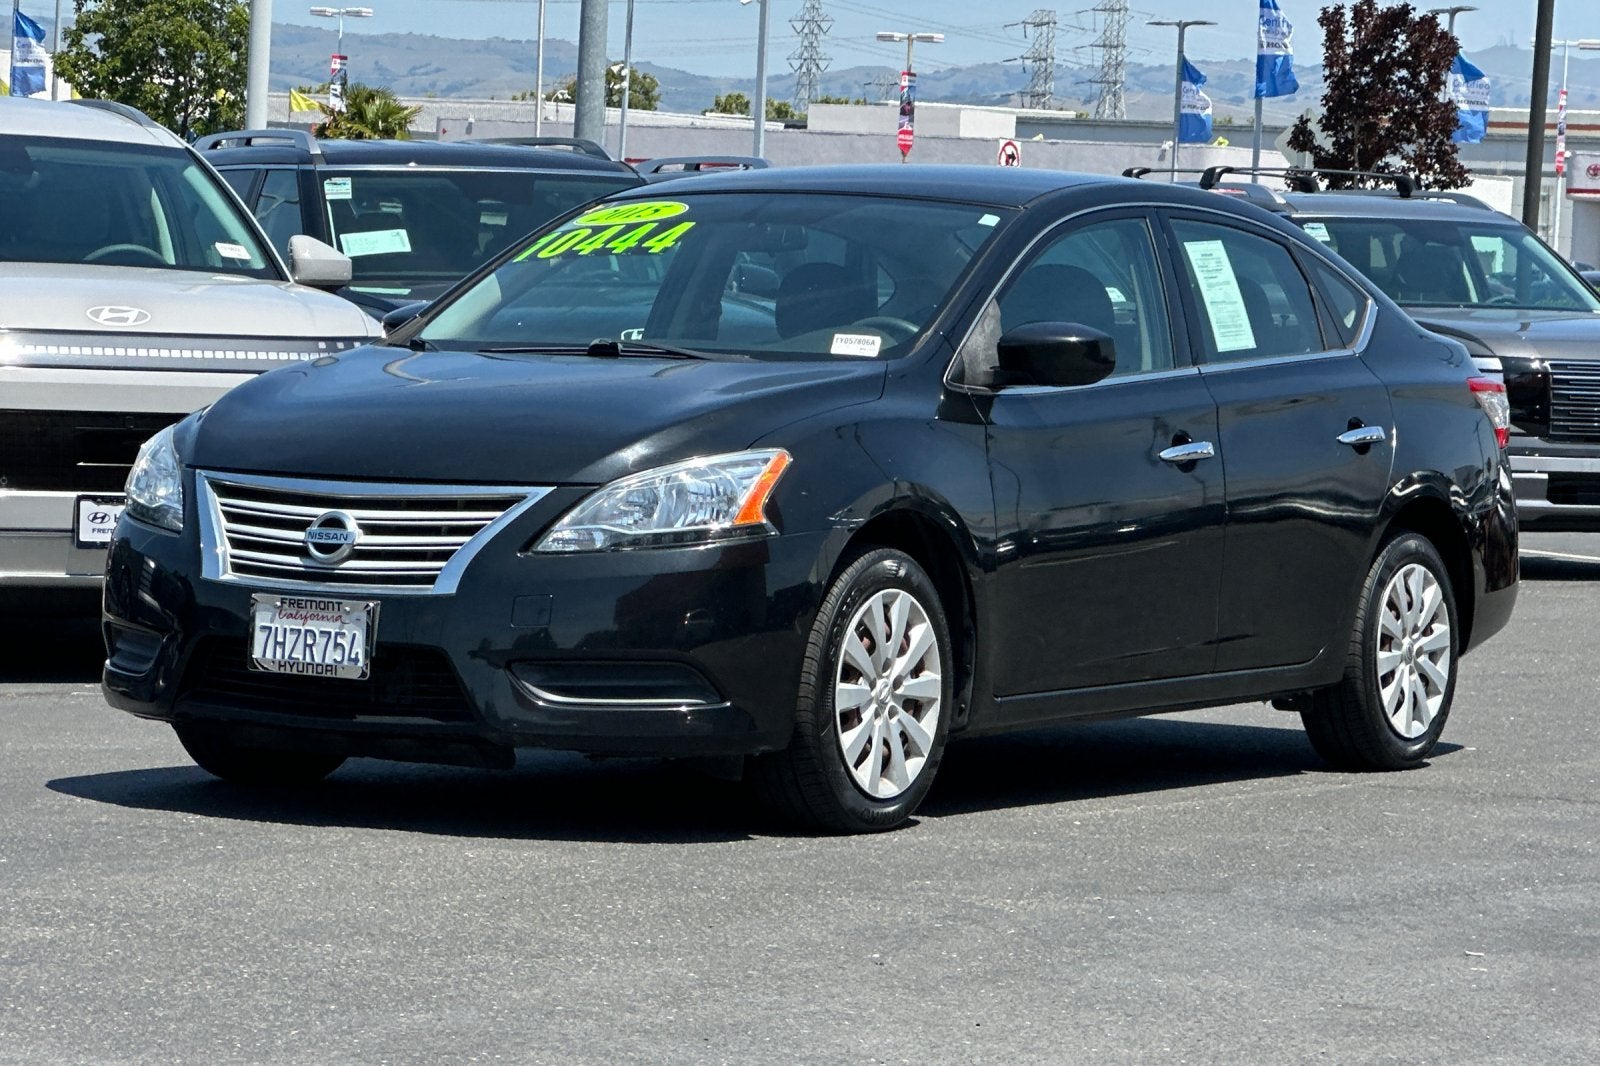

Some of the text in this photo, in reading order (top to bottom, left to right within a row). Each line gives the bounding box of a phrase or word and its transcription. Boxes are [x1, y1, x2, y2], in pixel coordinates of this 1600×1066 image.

[512, 221, 696, 263] 10444
[307, 531, 348, 541] NISSAN
[280, 597, 343, 612] FREMONT
[278, 609, 351, 626] California
[259, 625, 360, 666] 7HZR754
[278, 660, 338, 676] HYUNDAI
